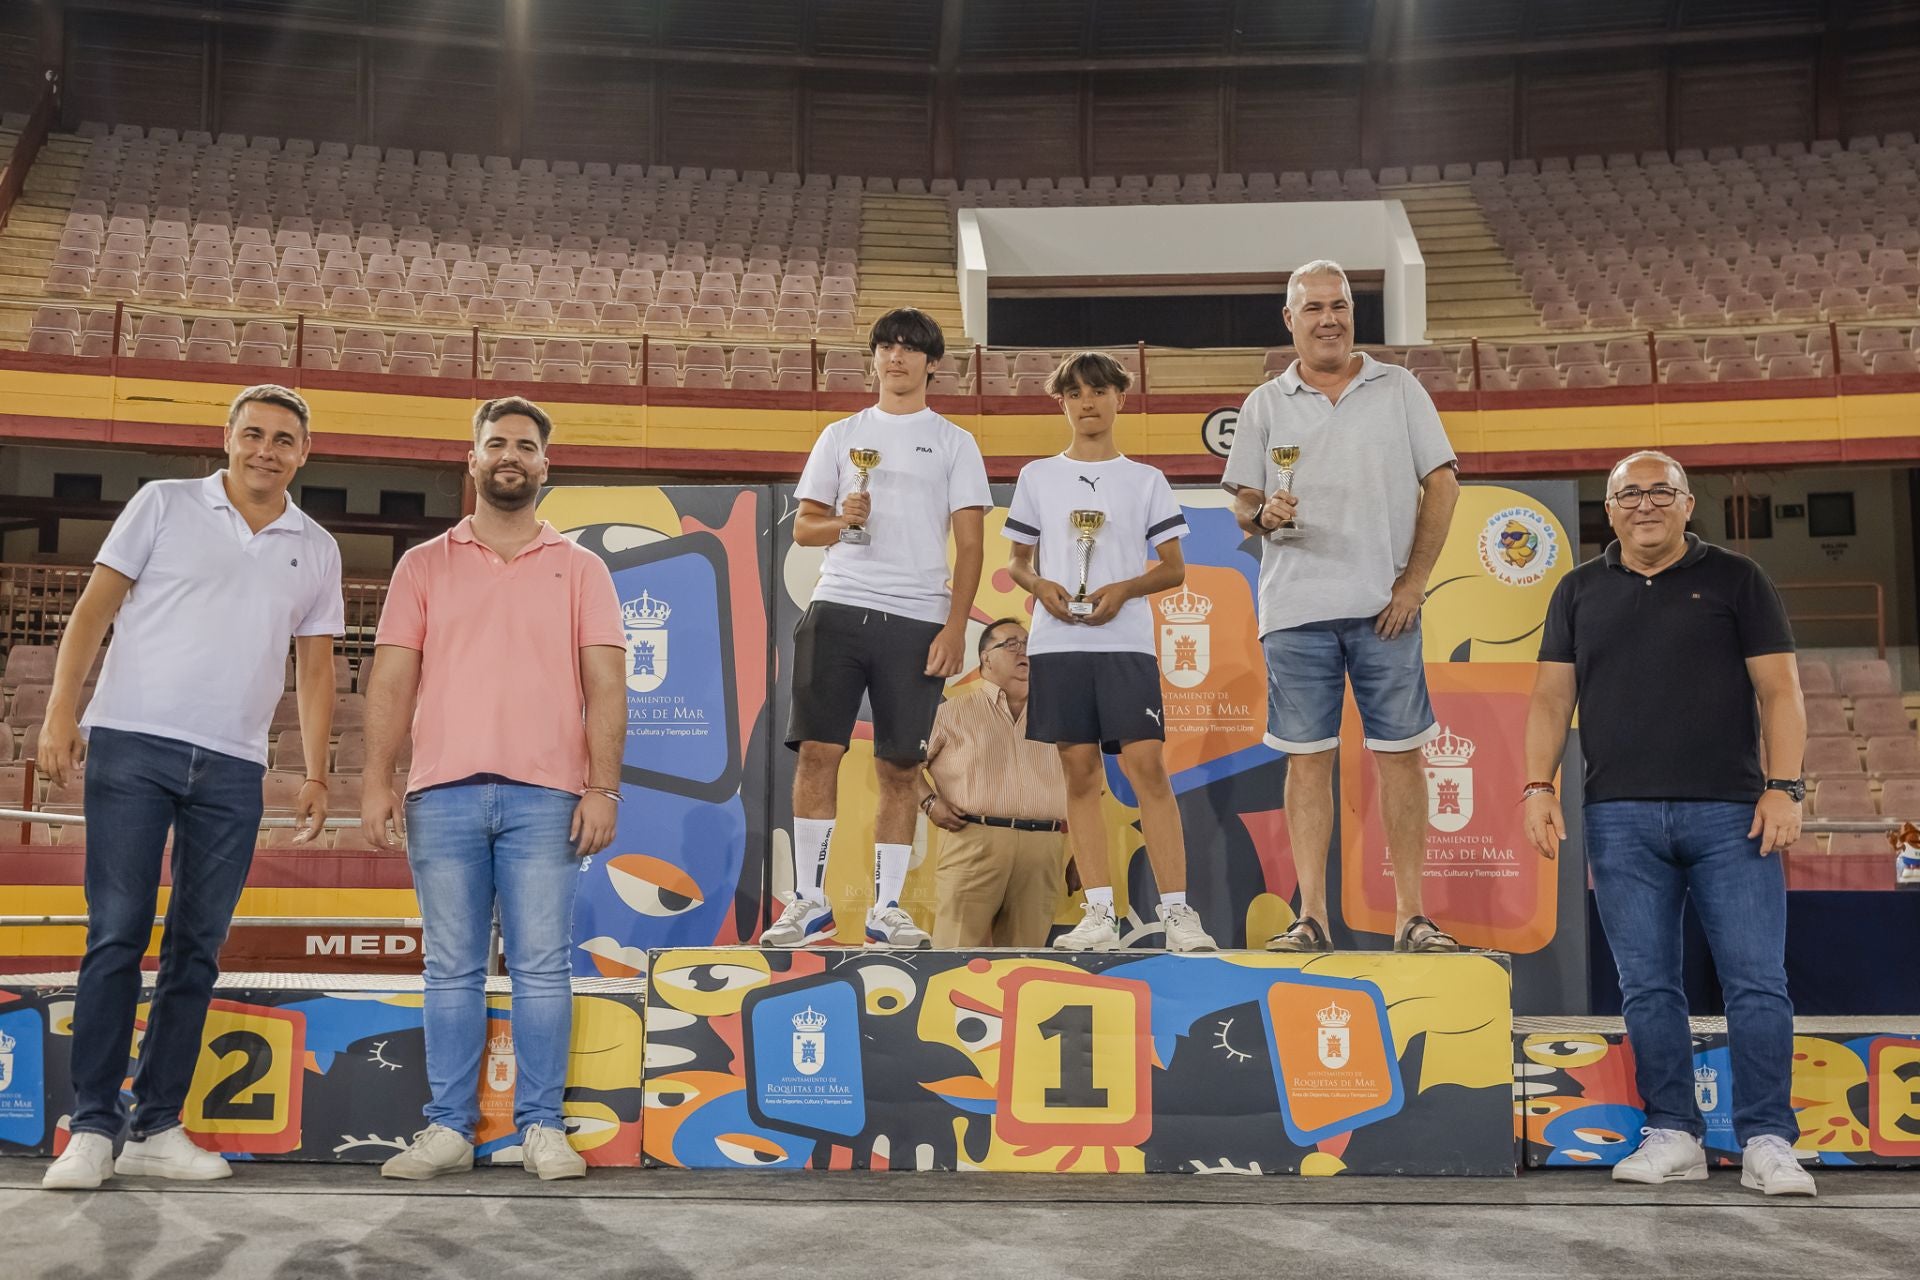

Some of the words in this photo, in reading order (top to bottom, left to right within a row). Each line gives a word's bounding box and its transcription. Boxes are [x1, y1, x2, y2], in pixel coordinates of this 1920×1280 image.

[1218, 418, 1238, 450] 5
[1544, 544, 1556, 567] MAR
[1498, 572, 1512, 584] LA
[1517, 573, 1541, 585] VIDA
[626, 696, 671, 704] TAMIENTO
[1161, 692, 1215, 700] NTAMIENTO
[1218, 692, 1229, 700] DE
[653, 709, 668, 719] DE
[1163, 705, 1190, 716] ETAS
[1196, 705, 1212, 715] DE
[636, 728, 660, 736] Cultura
[666, 728, 691, 737] Tiempo
[691, 728, 709, 736] Libre
[1210, 725, 1236, 734] Tiempo
[1425, 836, 1479, 844] NTAMIENTO
[1481, 836, 1494, 844] DE
[1460, 849, 1477, 860] DE
[1443, 868, 1468, 877] Cultura
[1475, 868, 1500, 877] Tiempo
[1501, 868, 1520, 877] Libre
[1037, 1005, 1108, 1107] 1
[202, 1030, 275, 1120] 2
[1294, 1077, 1338, 1087] ROQUETAS
[1341, 1079, 1352, 1087] DE
[767, 1083, 813, 1094] ROQUETAS
[815, 1085, 825, 1093] DE
